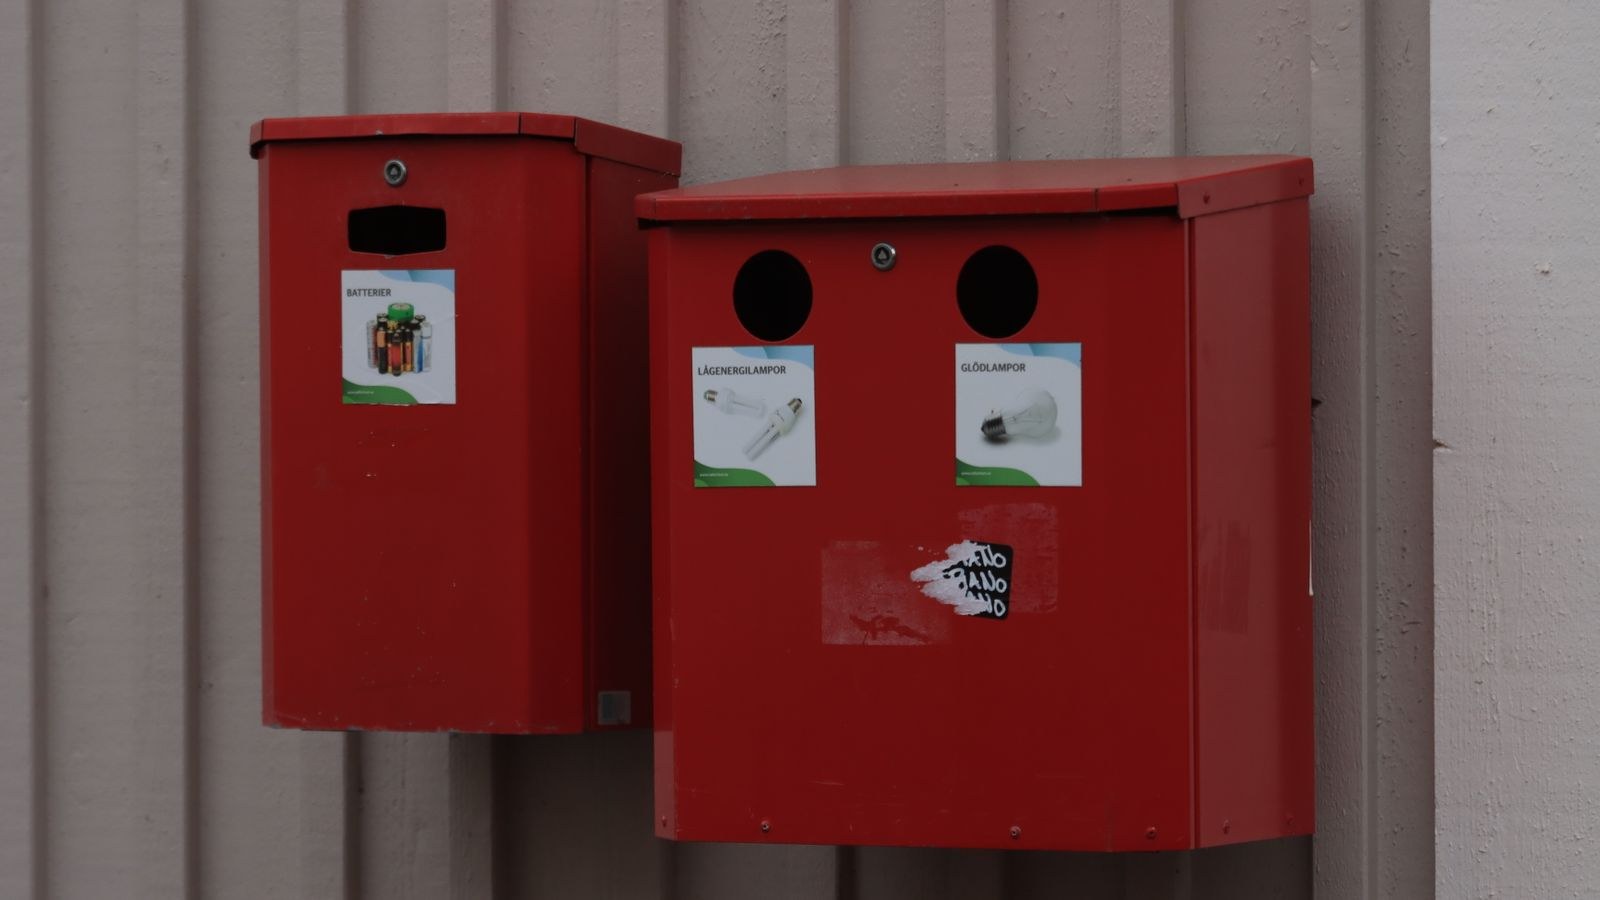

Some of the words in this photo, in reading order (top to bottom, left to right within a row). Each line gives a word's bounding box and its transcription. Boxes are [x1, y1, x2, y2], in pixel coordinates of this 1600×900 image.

[346, 288, 392, 297] BATTERIER
[697, 365, 787, 376] LÅGENERGILAMPOR
[961, 361, 1026, 373] GLÖDLAMPOR
